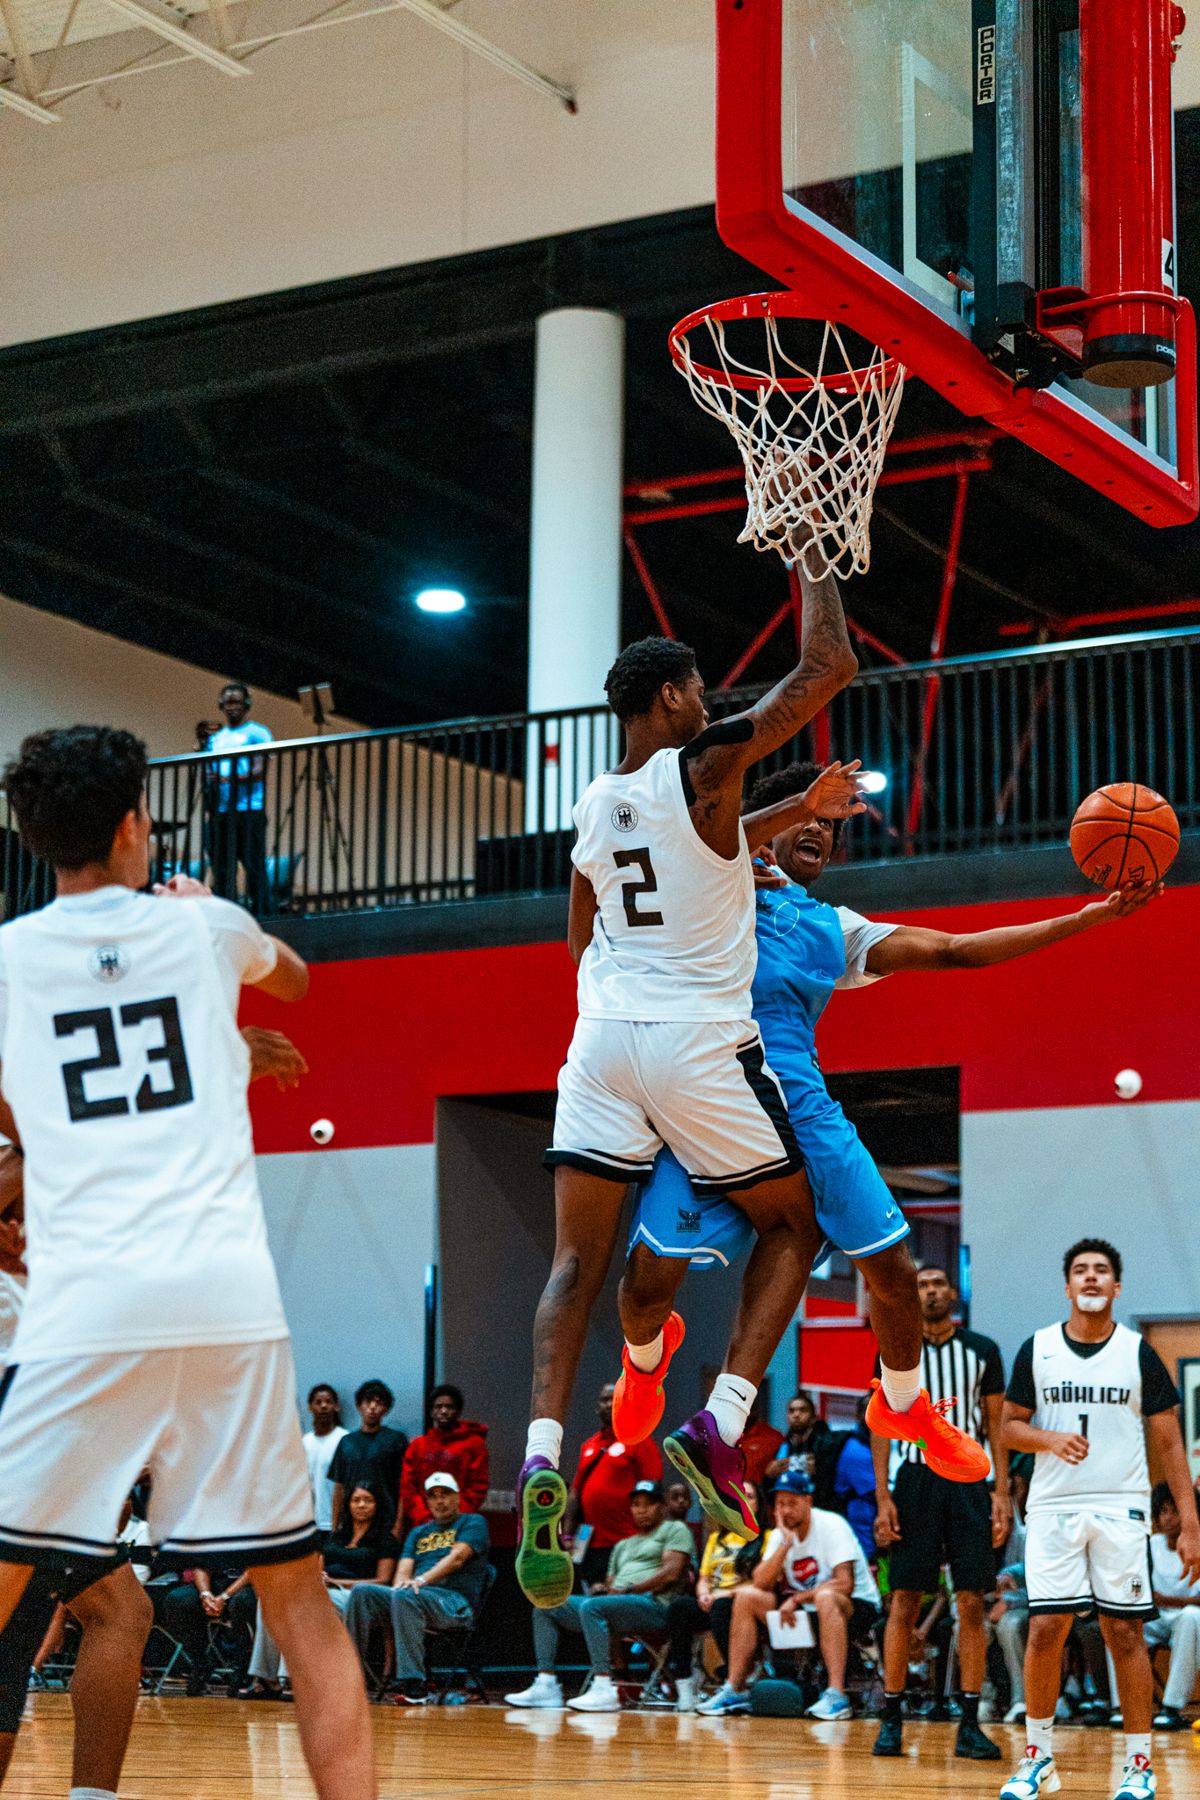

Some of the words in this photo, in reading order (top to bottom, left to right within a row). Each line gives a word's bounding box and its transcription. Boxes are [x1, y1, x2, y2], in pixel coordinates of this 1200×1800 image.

[612, 846, 664, 928] 2
[53, 996, 194, 1123] 23
[1042, 1380, 1131, 1405] FRÖHLICH
[1078, 1414, 1089, 1438] 1
